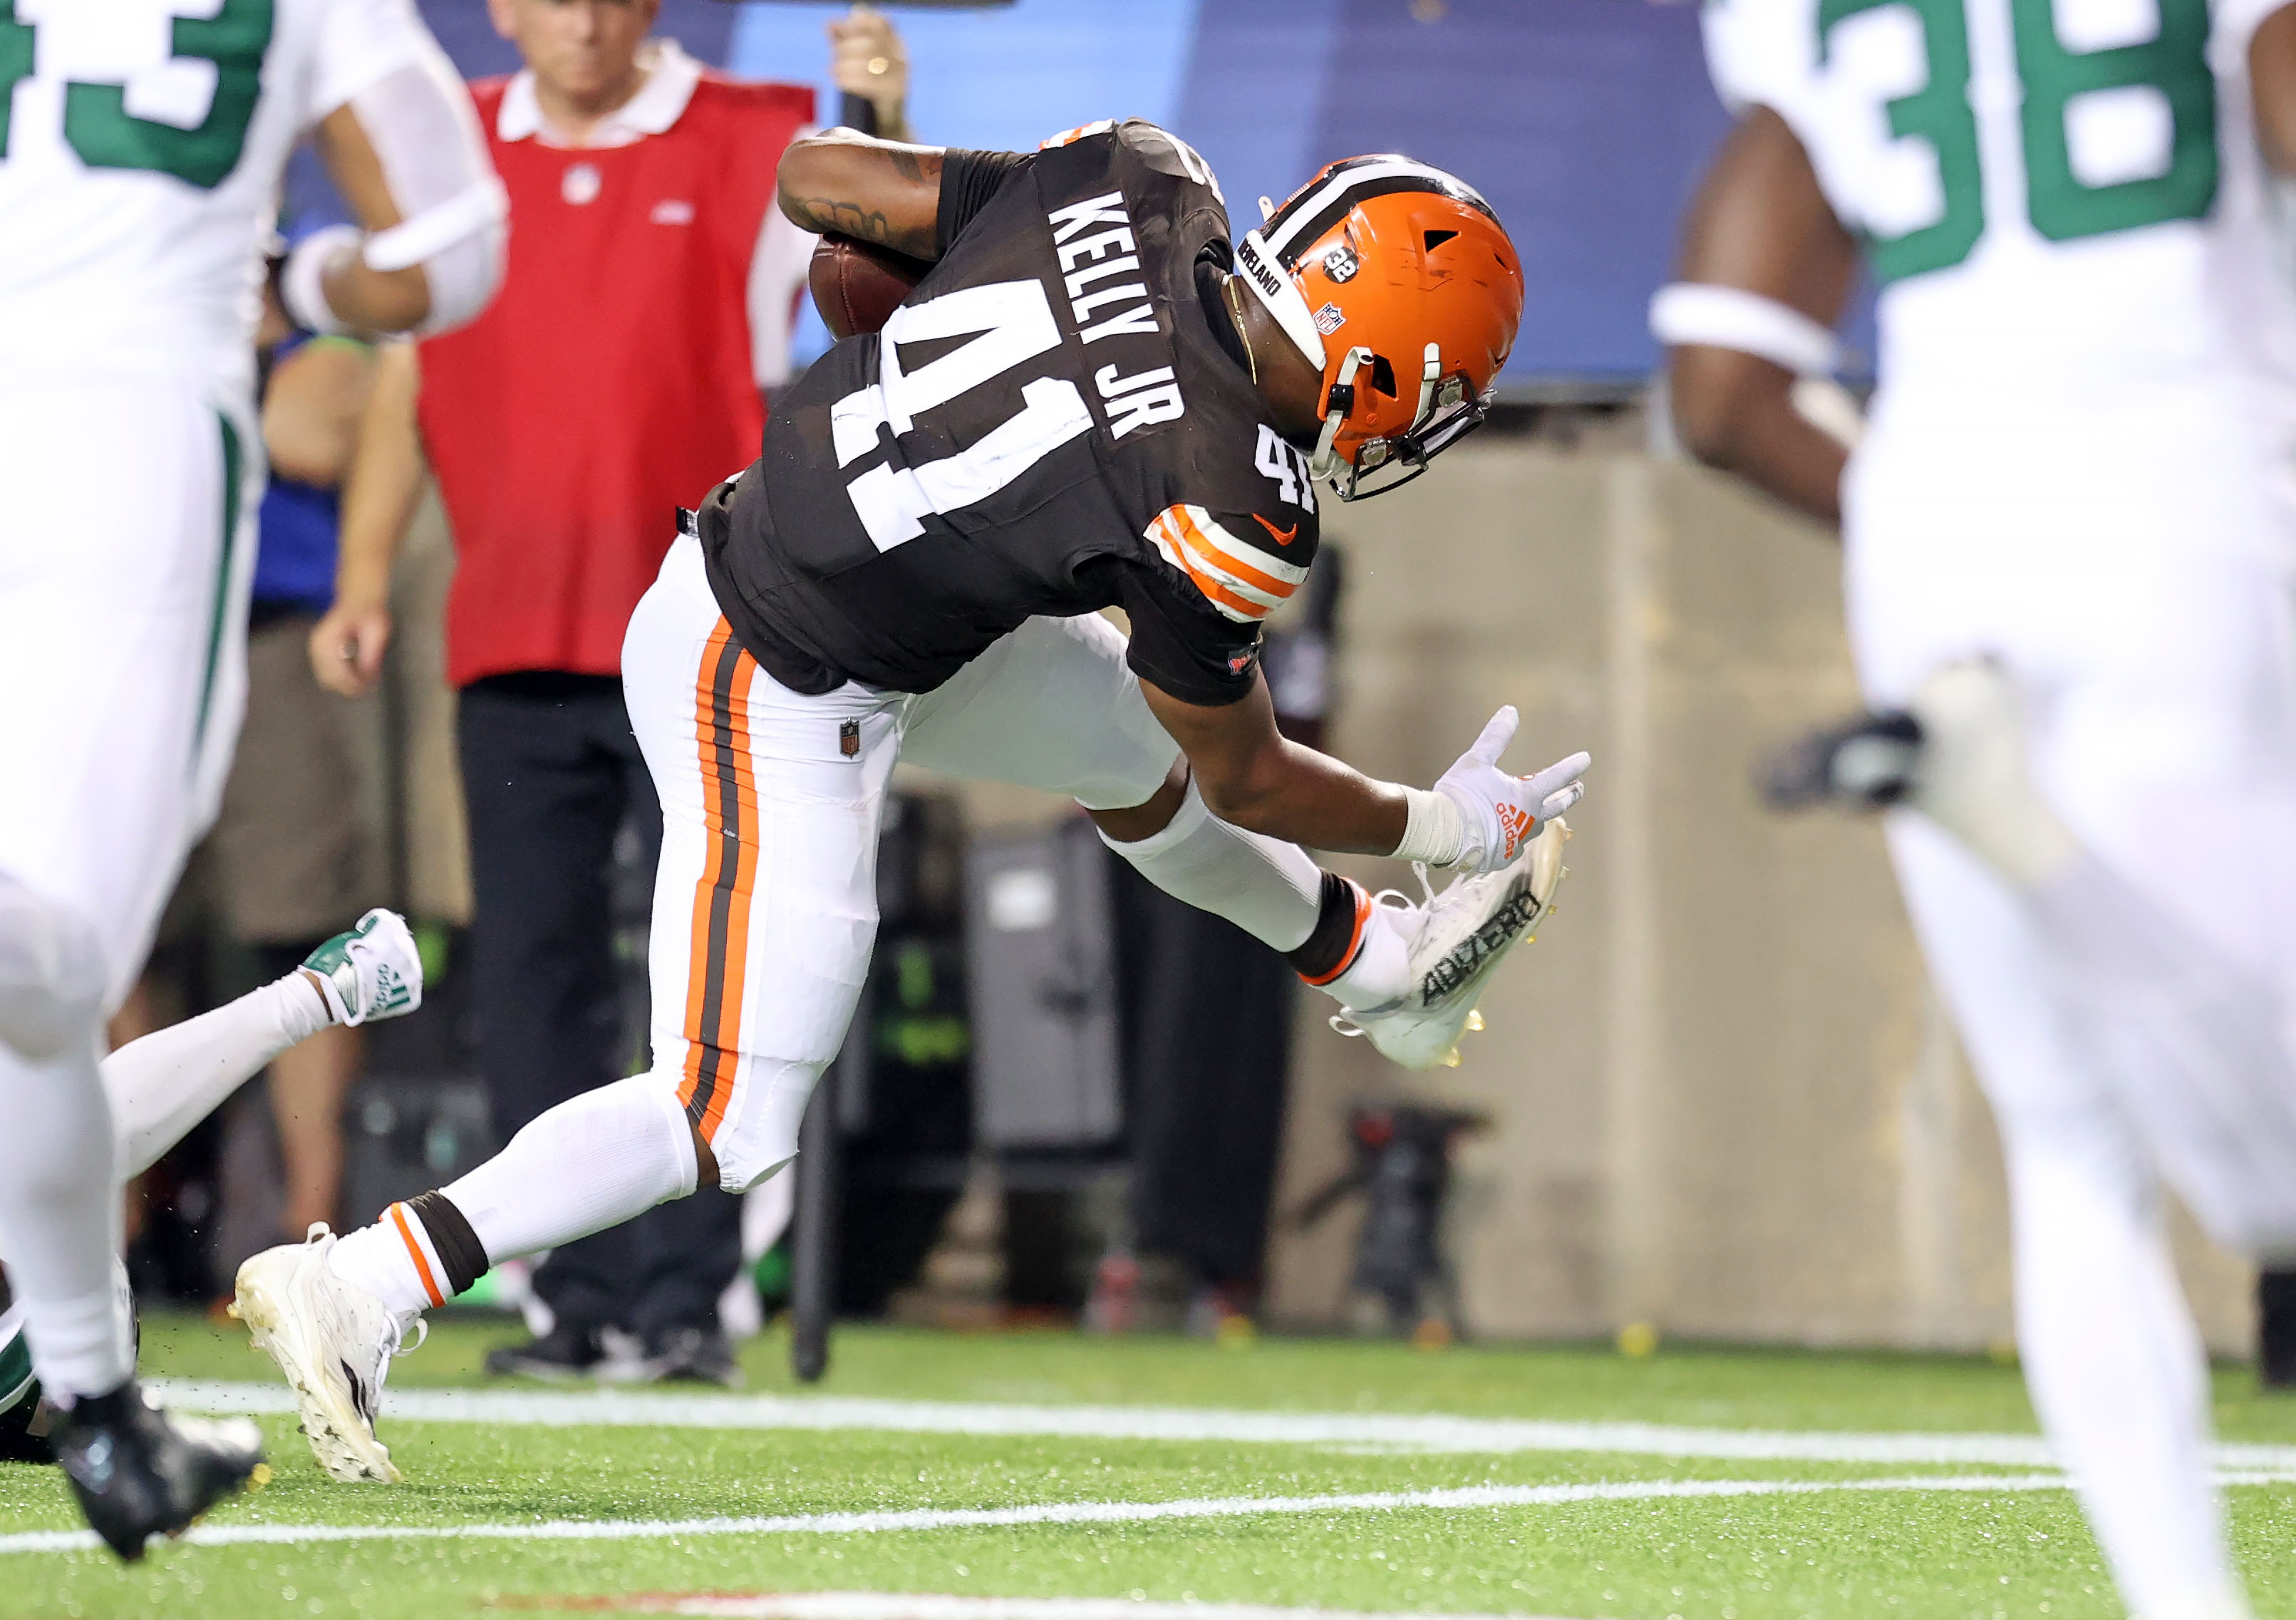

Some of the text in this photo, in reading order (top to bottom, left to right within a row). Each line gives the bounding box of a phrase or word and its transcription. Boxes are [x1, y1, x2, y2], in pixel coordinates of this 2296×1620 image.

[0, 0, 274, 188] 3
[1816, 0, 2220, 282] 38
[1048, 190, 1185, 440] KELLY JR
[1316, 313, 1335, 332] NFL
[1325, 249, 1356, 283] 32
[831, 279, 1095, 553] 41
[1255, 423, 1315, 515] 41
[1496, 802, 1517, 859] adidas
